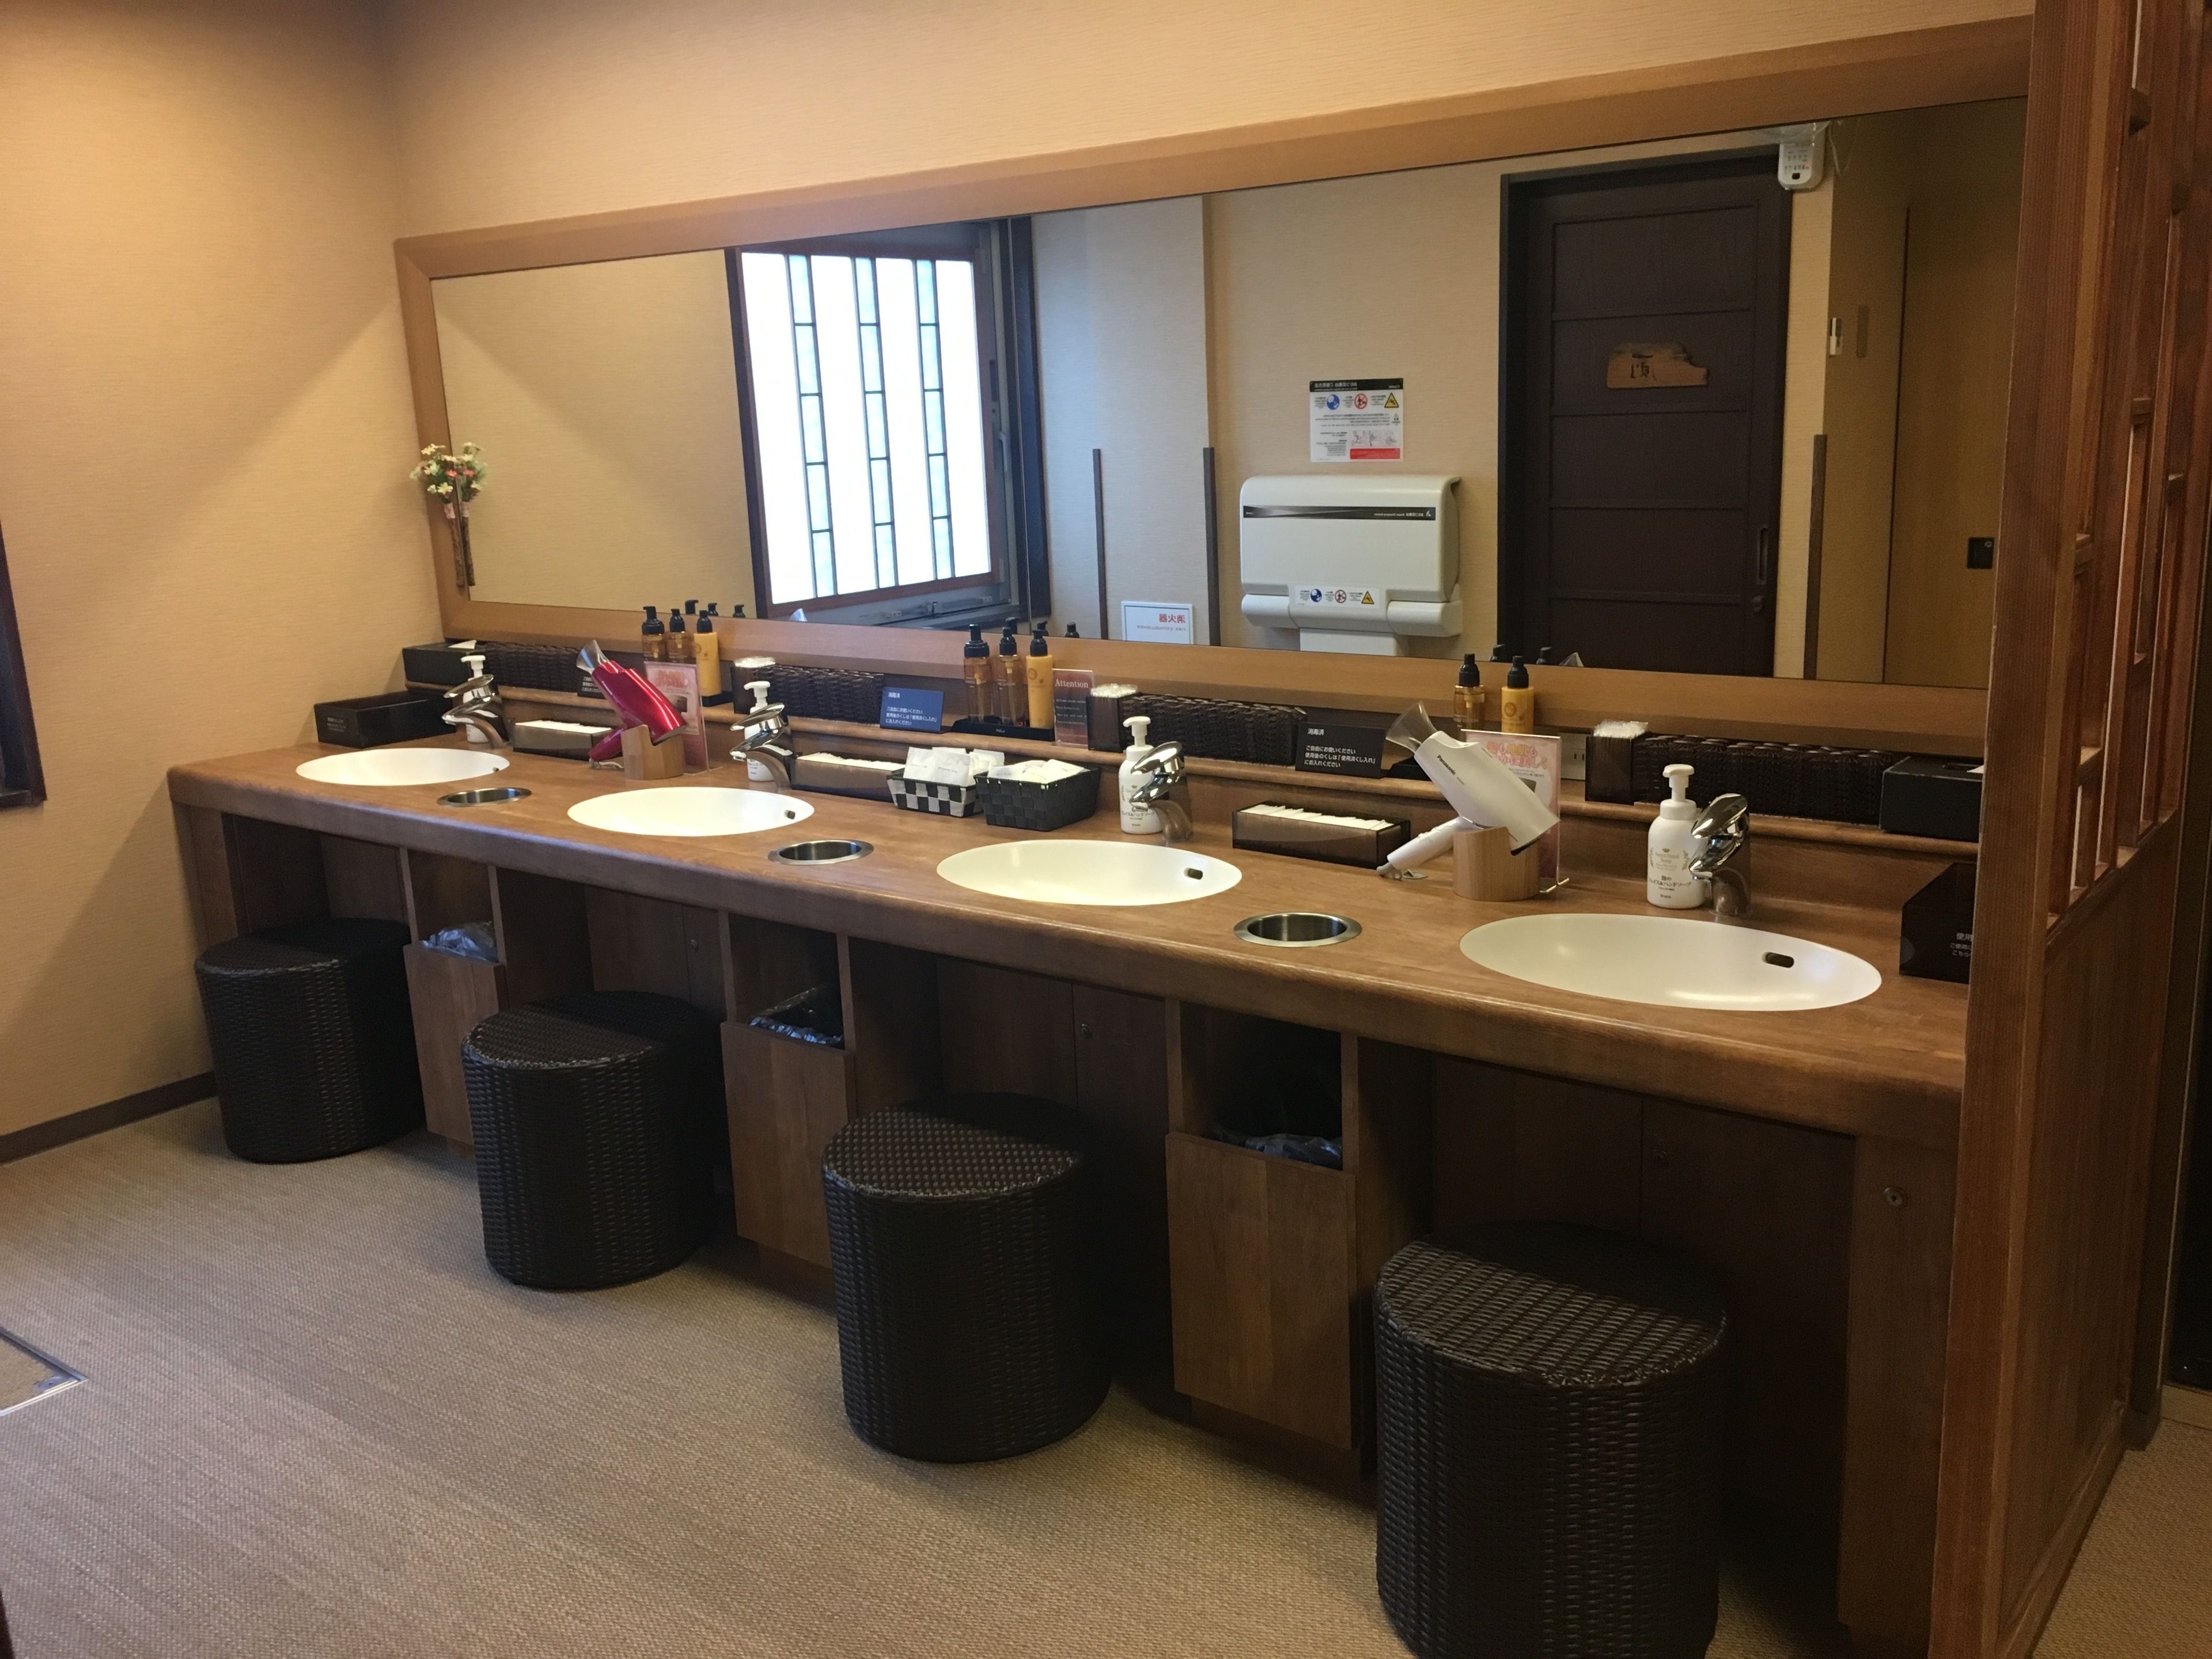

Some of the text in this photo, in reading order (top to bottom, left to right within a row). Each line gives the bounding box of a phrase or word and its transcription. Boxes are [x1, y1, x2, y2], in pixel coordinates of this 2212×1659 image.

[1055, 678, 1089, 688] Attention
[1307, 728, 1324, 736] 消毒済
[1305, 745, 1356, 755] ご自由にお使いください
[1304, 752, 1376, 764] 使用後のくしは「使用済くし入れ」
[1304, 759, 1341, 768] にお入れください
[1437, 755, 1456, 776] Panasonic
